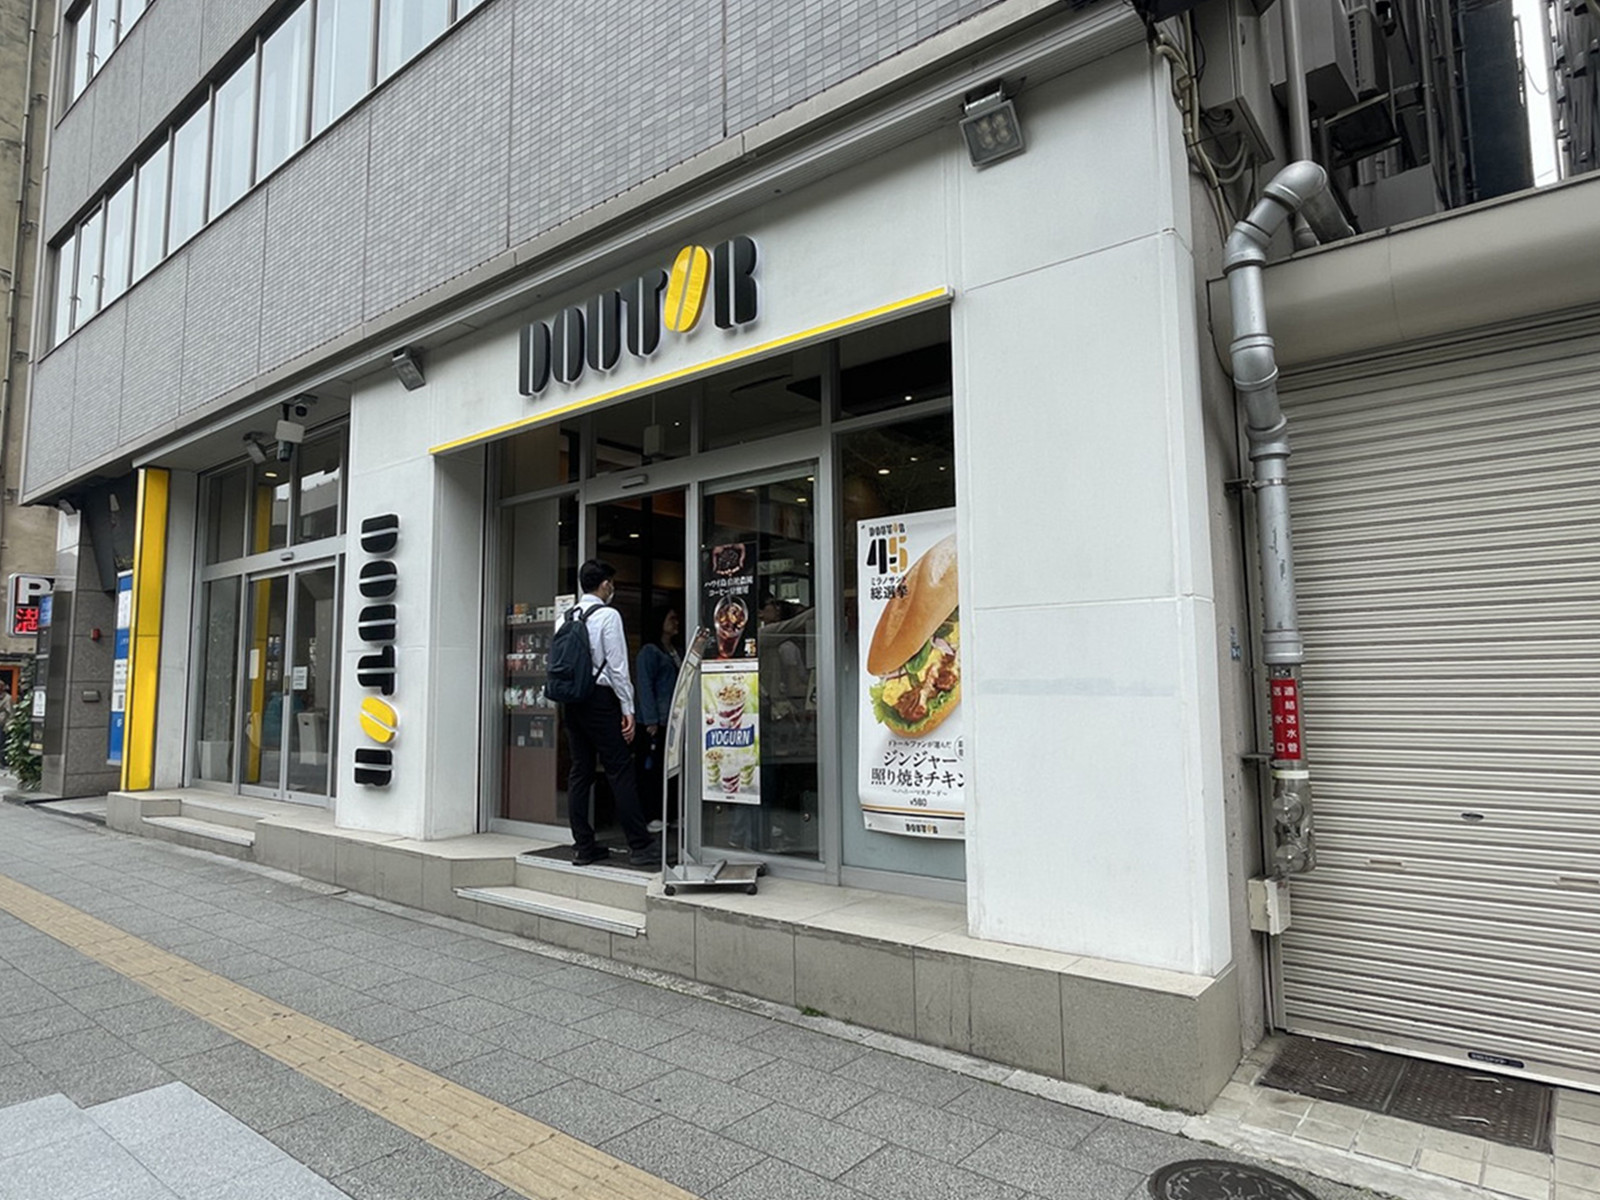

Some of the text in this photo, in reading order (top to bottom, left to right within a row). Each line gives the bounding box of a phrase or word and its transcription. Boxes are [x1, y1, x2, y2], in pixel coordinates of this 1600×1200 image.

[518, 235, 758, 398] DOUTOR
[866, 535, 909, 575] 45
[17, 577, 51, 605] P
[870, 584, 908, 600] 総選挙
[354, 513, 400, 788] DOUTOR
[710, 729, 751, 746] YOGURN
[883, 749, 958, 770] ジンジャー
